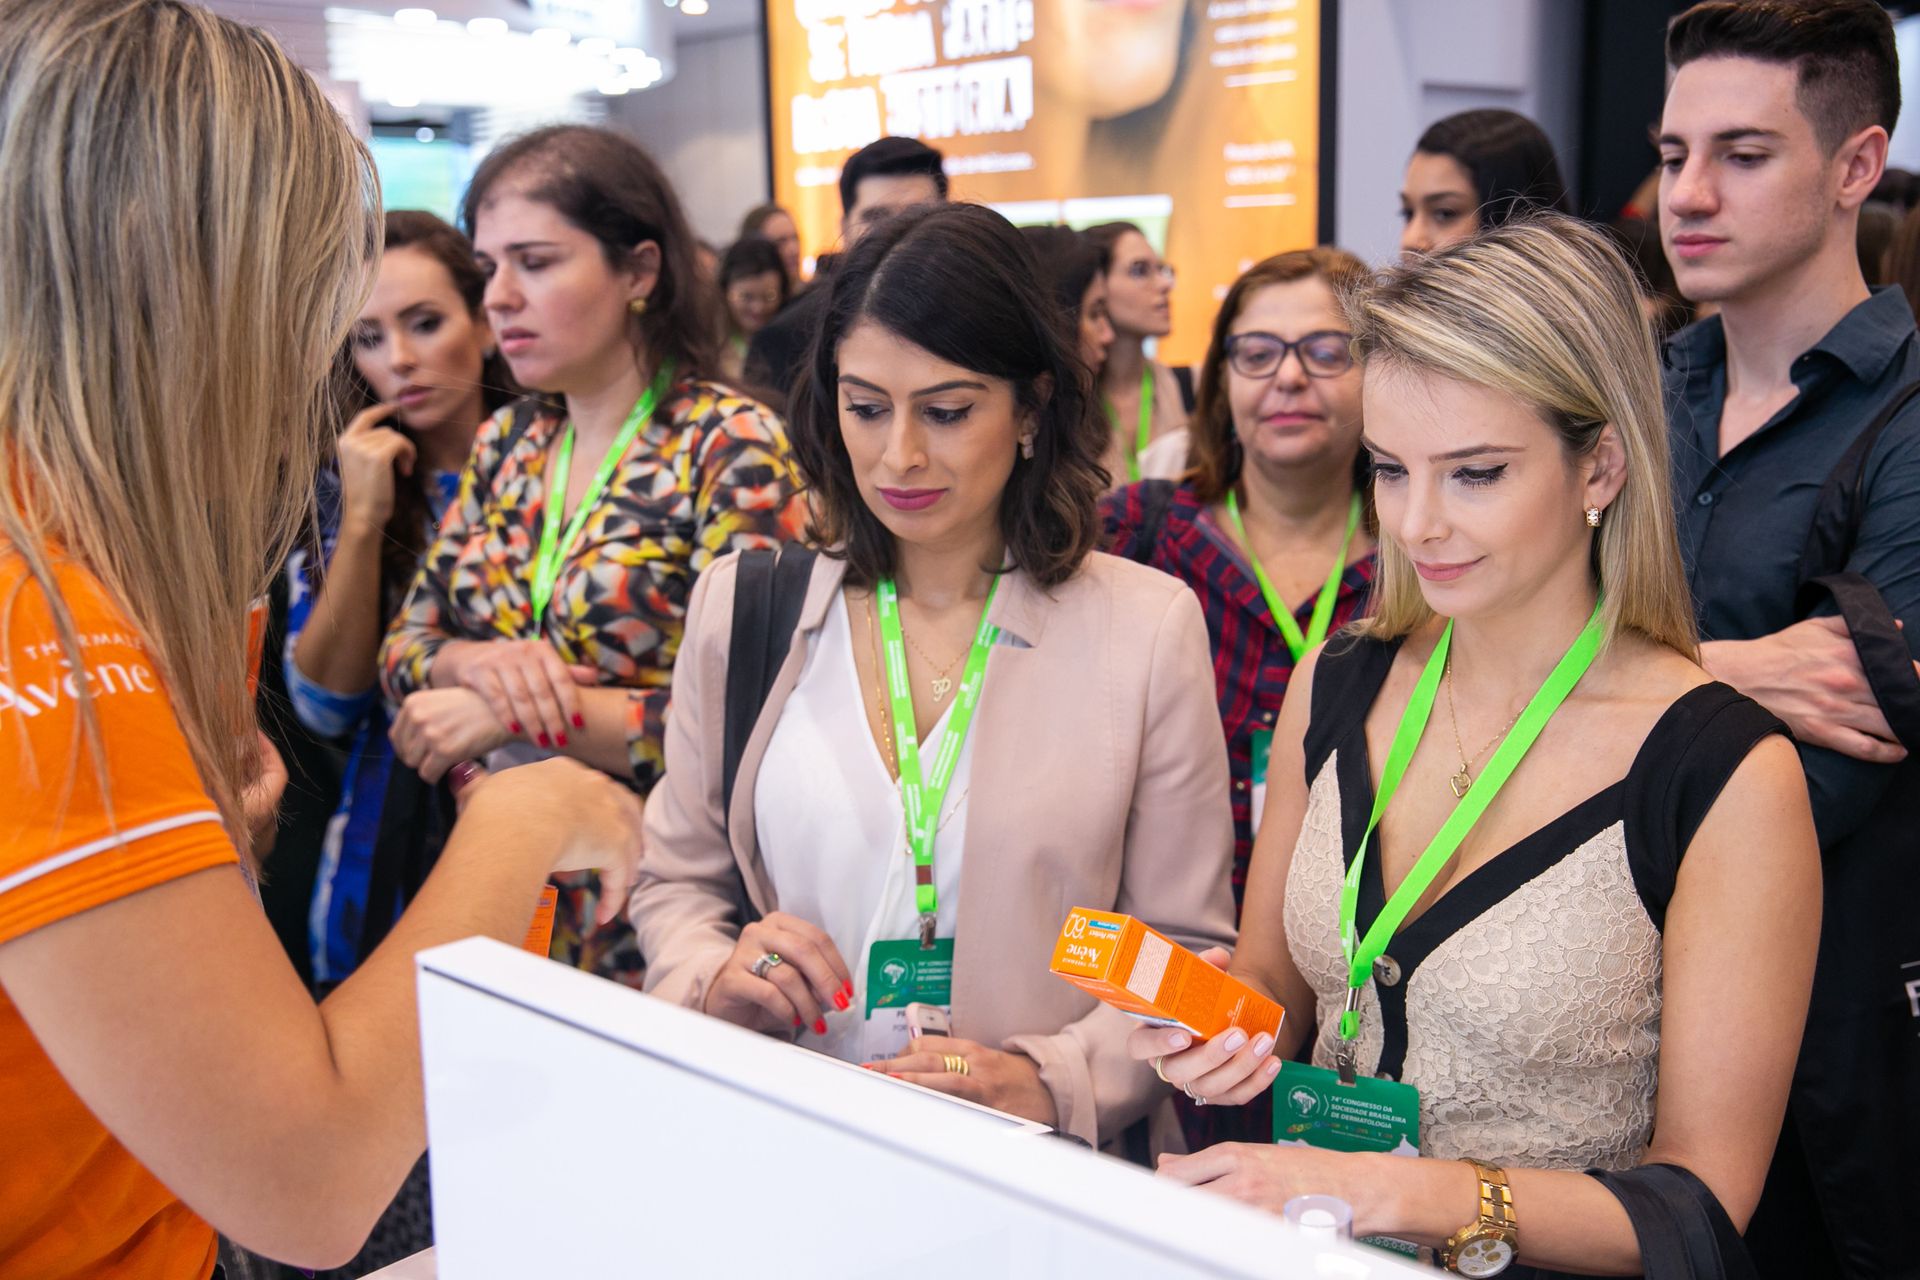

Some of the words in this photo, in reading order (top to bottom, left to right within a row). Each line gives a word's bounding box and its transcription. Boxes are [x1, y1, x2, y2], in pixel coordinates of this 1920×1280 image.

[0, 658, 156, 718] Avène
[1063, 915, 1087, 939] 60
[1066, 944, 1102, 963] Avène
[1330, 1103, 1369, 1117] SOCIEDADE
[1368, 1111, 1407, 1124] BRASILEIRA
[1342, 1098, 1382, 1111] CONGRESSO
[1330, 1111, 1340, 1119] DE
[1340, 1113, 1392, 1129] DERMATOLOGIA
